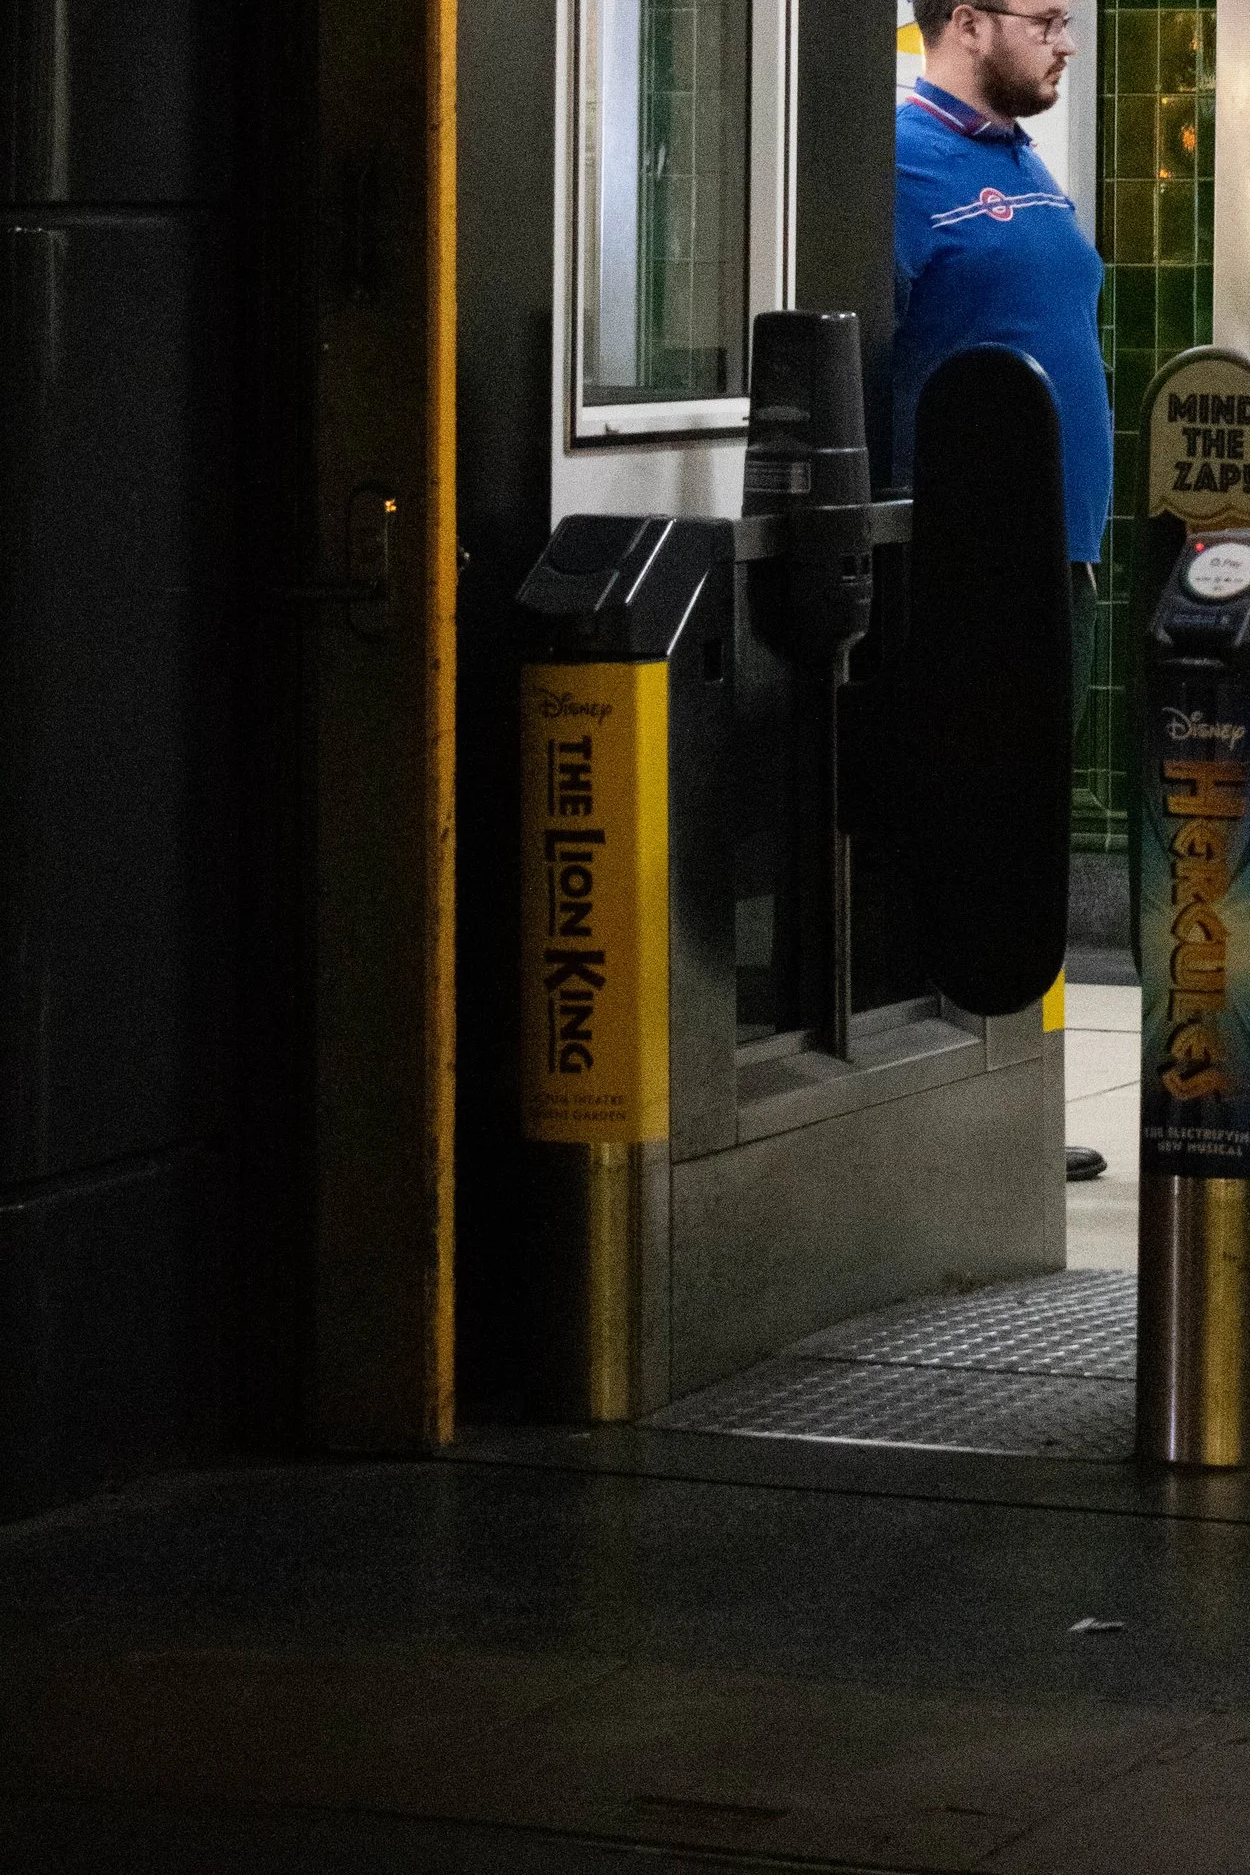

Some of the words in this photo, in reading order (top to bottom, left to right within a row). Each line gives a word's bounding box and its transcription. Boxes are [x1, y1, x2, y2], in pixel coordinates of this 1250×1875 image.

[1181, 427, 1245, 460] THE
[1161, 706, 1247, 750] Disney
[558, 735, 593, 817] THE
